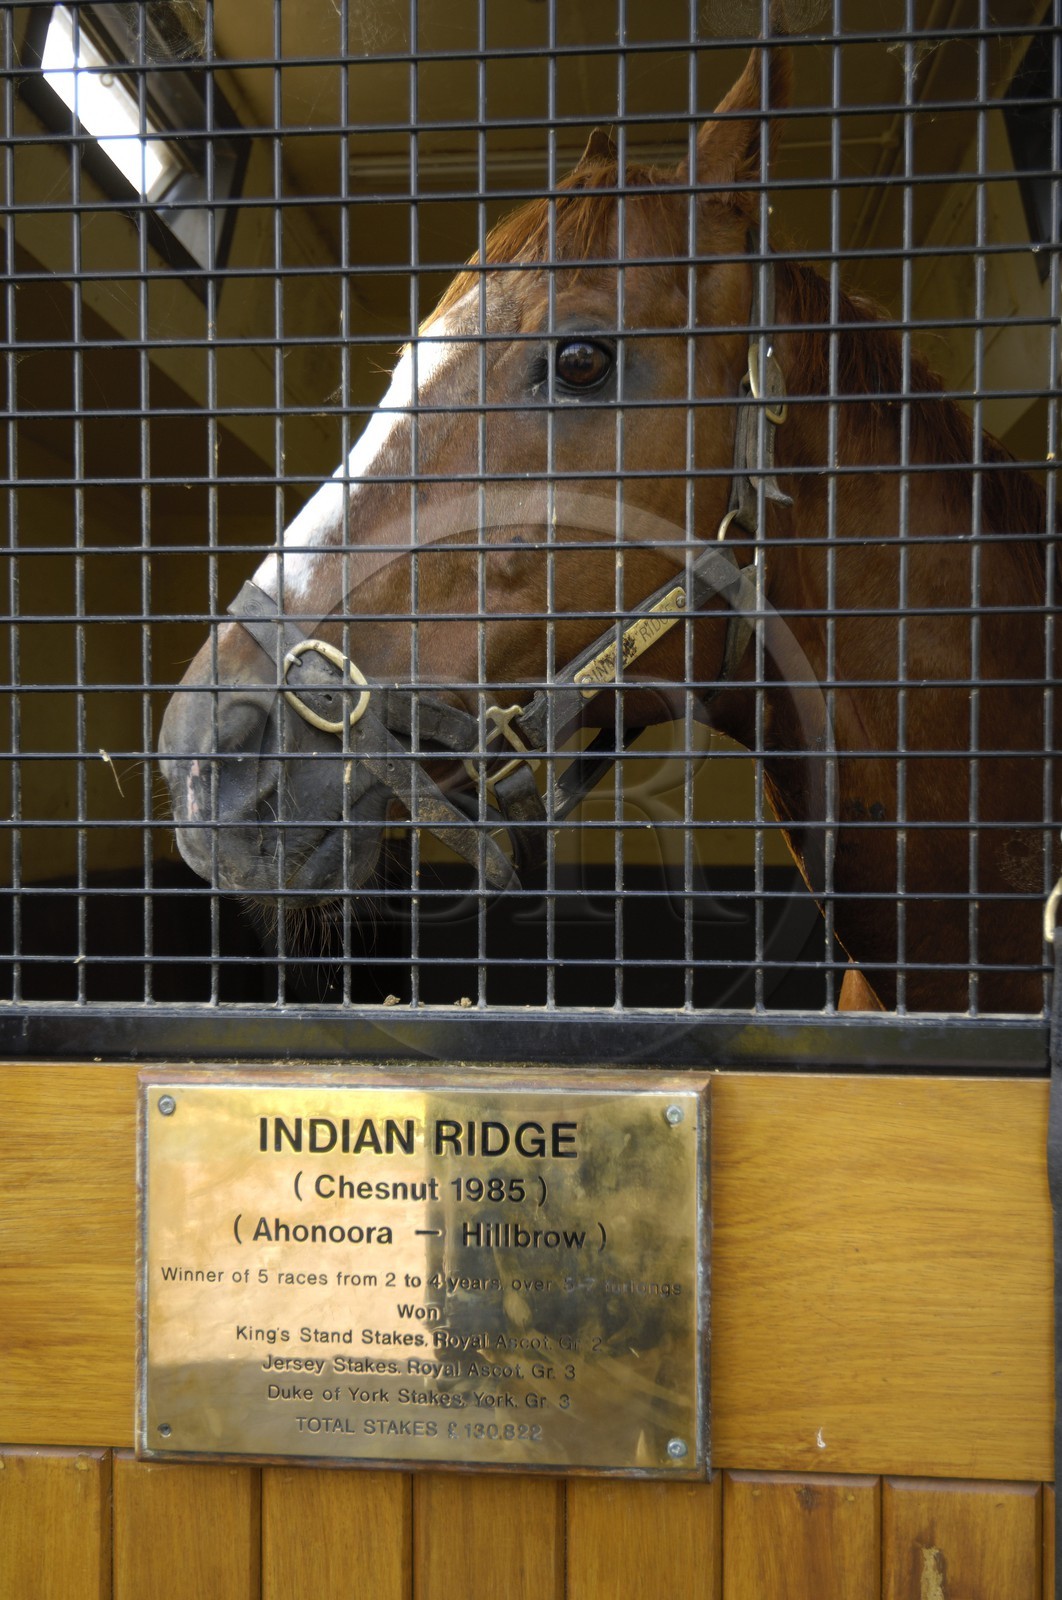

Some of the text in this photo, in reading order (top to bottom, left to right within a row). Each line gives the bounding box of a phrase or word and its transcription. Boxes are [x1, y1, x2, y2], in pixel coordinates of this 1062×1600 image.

[259, 1117, 578, 1159] INDIAN RIDGE
[161, 1266, 225, 1284] Winner
[231, 1270, 251, 1284] of
[257, 1268, 269, 1284] 5
[277, 1271, 328, 1286] races
[336, 1271, 378, 1287] from
[384, 1272, 397, 1288] 2
[403, 1273, 422, 1288] to
[429, 1272, 444, 1290] 4
[511, 1279, 554, 1292] over
[397, 1303, 440, 1321] Won
[235, 1325, 291, 1345] King's
[299, 1327, 353, 1344] Stand
[433, 1330, 490, 1351] Royal
[262, 1355, 326, 1376] Jersey
[406, 1359, 462, 1379] Royal
[531, 1363, 556, 1380] Gr.
[564, 1364, 577, 1381] 3
[267, 1385, 315, 1401] Duke
[322, 1387, 341, 1402] of
[348, 1387, 390, 1404] York
[558, 1394, 572, 1411] 3
[296, 1416, 356, 1433] TOTAL
[363, 1418, 438, 1438] STAKES
